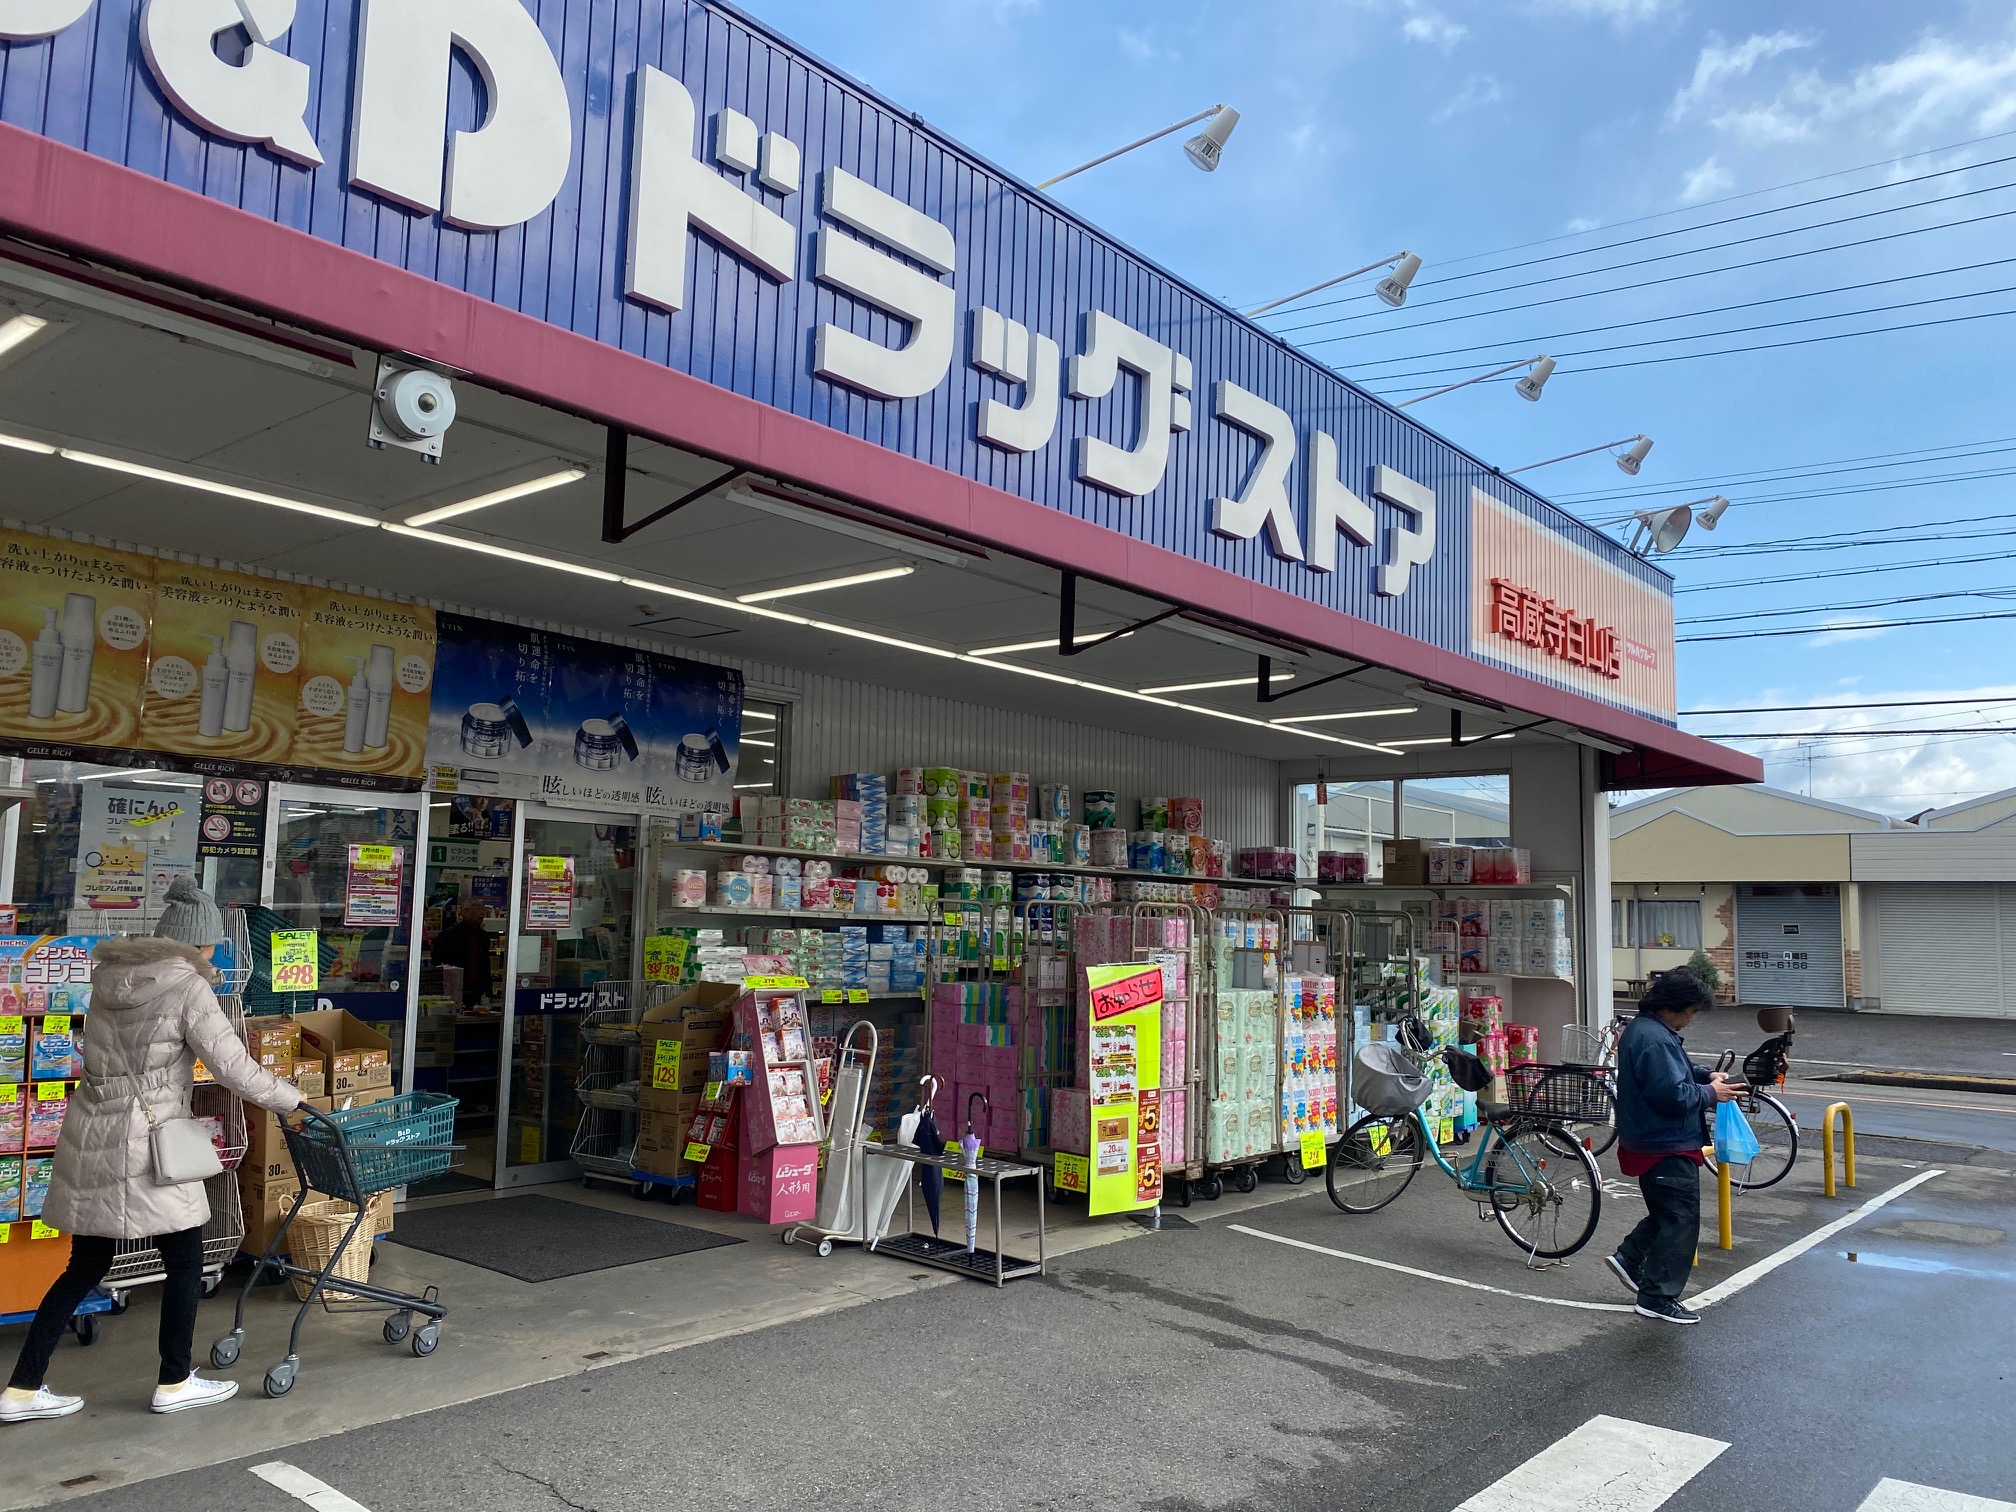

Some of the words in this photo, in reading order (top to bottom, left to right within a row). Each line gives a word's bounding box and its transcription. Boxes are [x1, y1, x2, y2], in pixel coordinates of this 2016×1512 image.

[0, 0, 572, 231] &D
[624, 63, 1436, 598] ドラッグストア
[8, 542, 126, 573] 洗い上がりはまるで
[0, 556, 148, 590] 容液をつけたような潤い
[160, 586, 301, 617] 美容液をつけたような潤い
[180, 575, 284, 602] 洗い上がりはまるで
[313, 611, 433, 640] 美容液をつけたような潤い
[329, 600, 417, 626] 洗い上がりはまるで
[1491, 577, 1621, 679] 高蔵寺白山店
[530, 632, 541, 684] 肌運命を
[1627, 642, 1656, 664] ツルハグループ
[515, 643, 528, 695] 切り拓く
[635, 652, 645, 701] 肌運命を
[623, 662, 634, 712] 切り拓く
[726, 671, 736, 717] 肌運命を
[717, 681, 726, 727] 切り拓く
[52, 749, 72, 757] RICH
[217, 765, 235, 773] RICH
[360, 779, 377, 787] RICH
[542, 774, 640, 804] 眩しいほどの透明感
[646, 785, 731, 814] 眩しいほどの透明感
[202, 846, 258, 855] 防犯カメラ設置店
[35, 946, 86, 959] タンスに
[1753, 961, 1808, 969] 51-6156
[1784, 952, 1808, 960] 月曜日
[26, 959, 98, 983] ゴンゴ
[1098, 980, 1157, 1014] お知らせ
[385, 1132, 421, 1147] ドラッグストア
[775, 1163, 815, 1178] ムシューダ
[776, 1180, 810, 1197] 人形用
